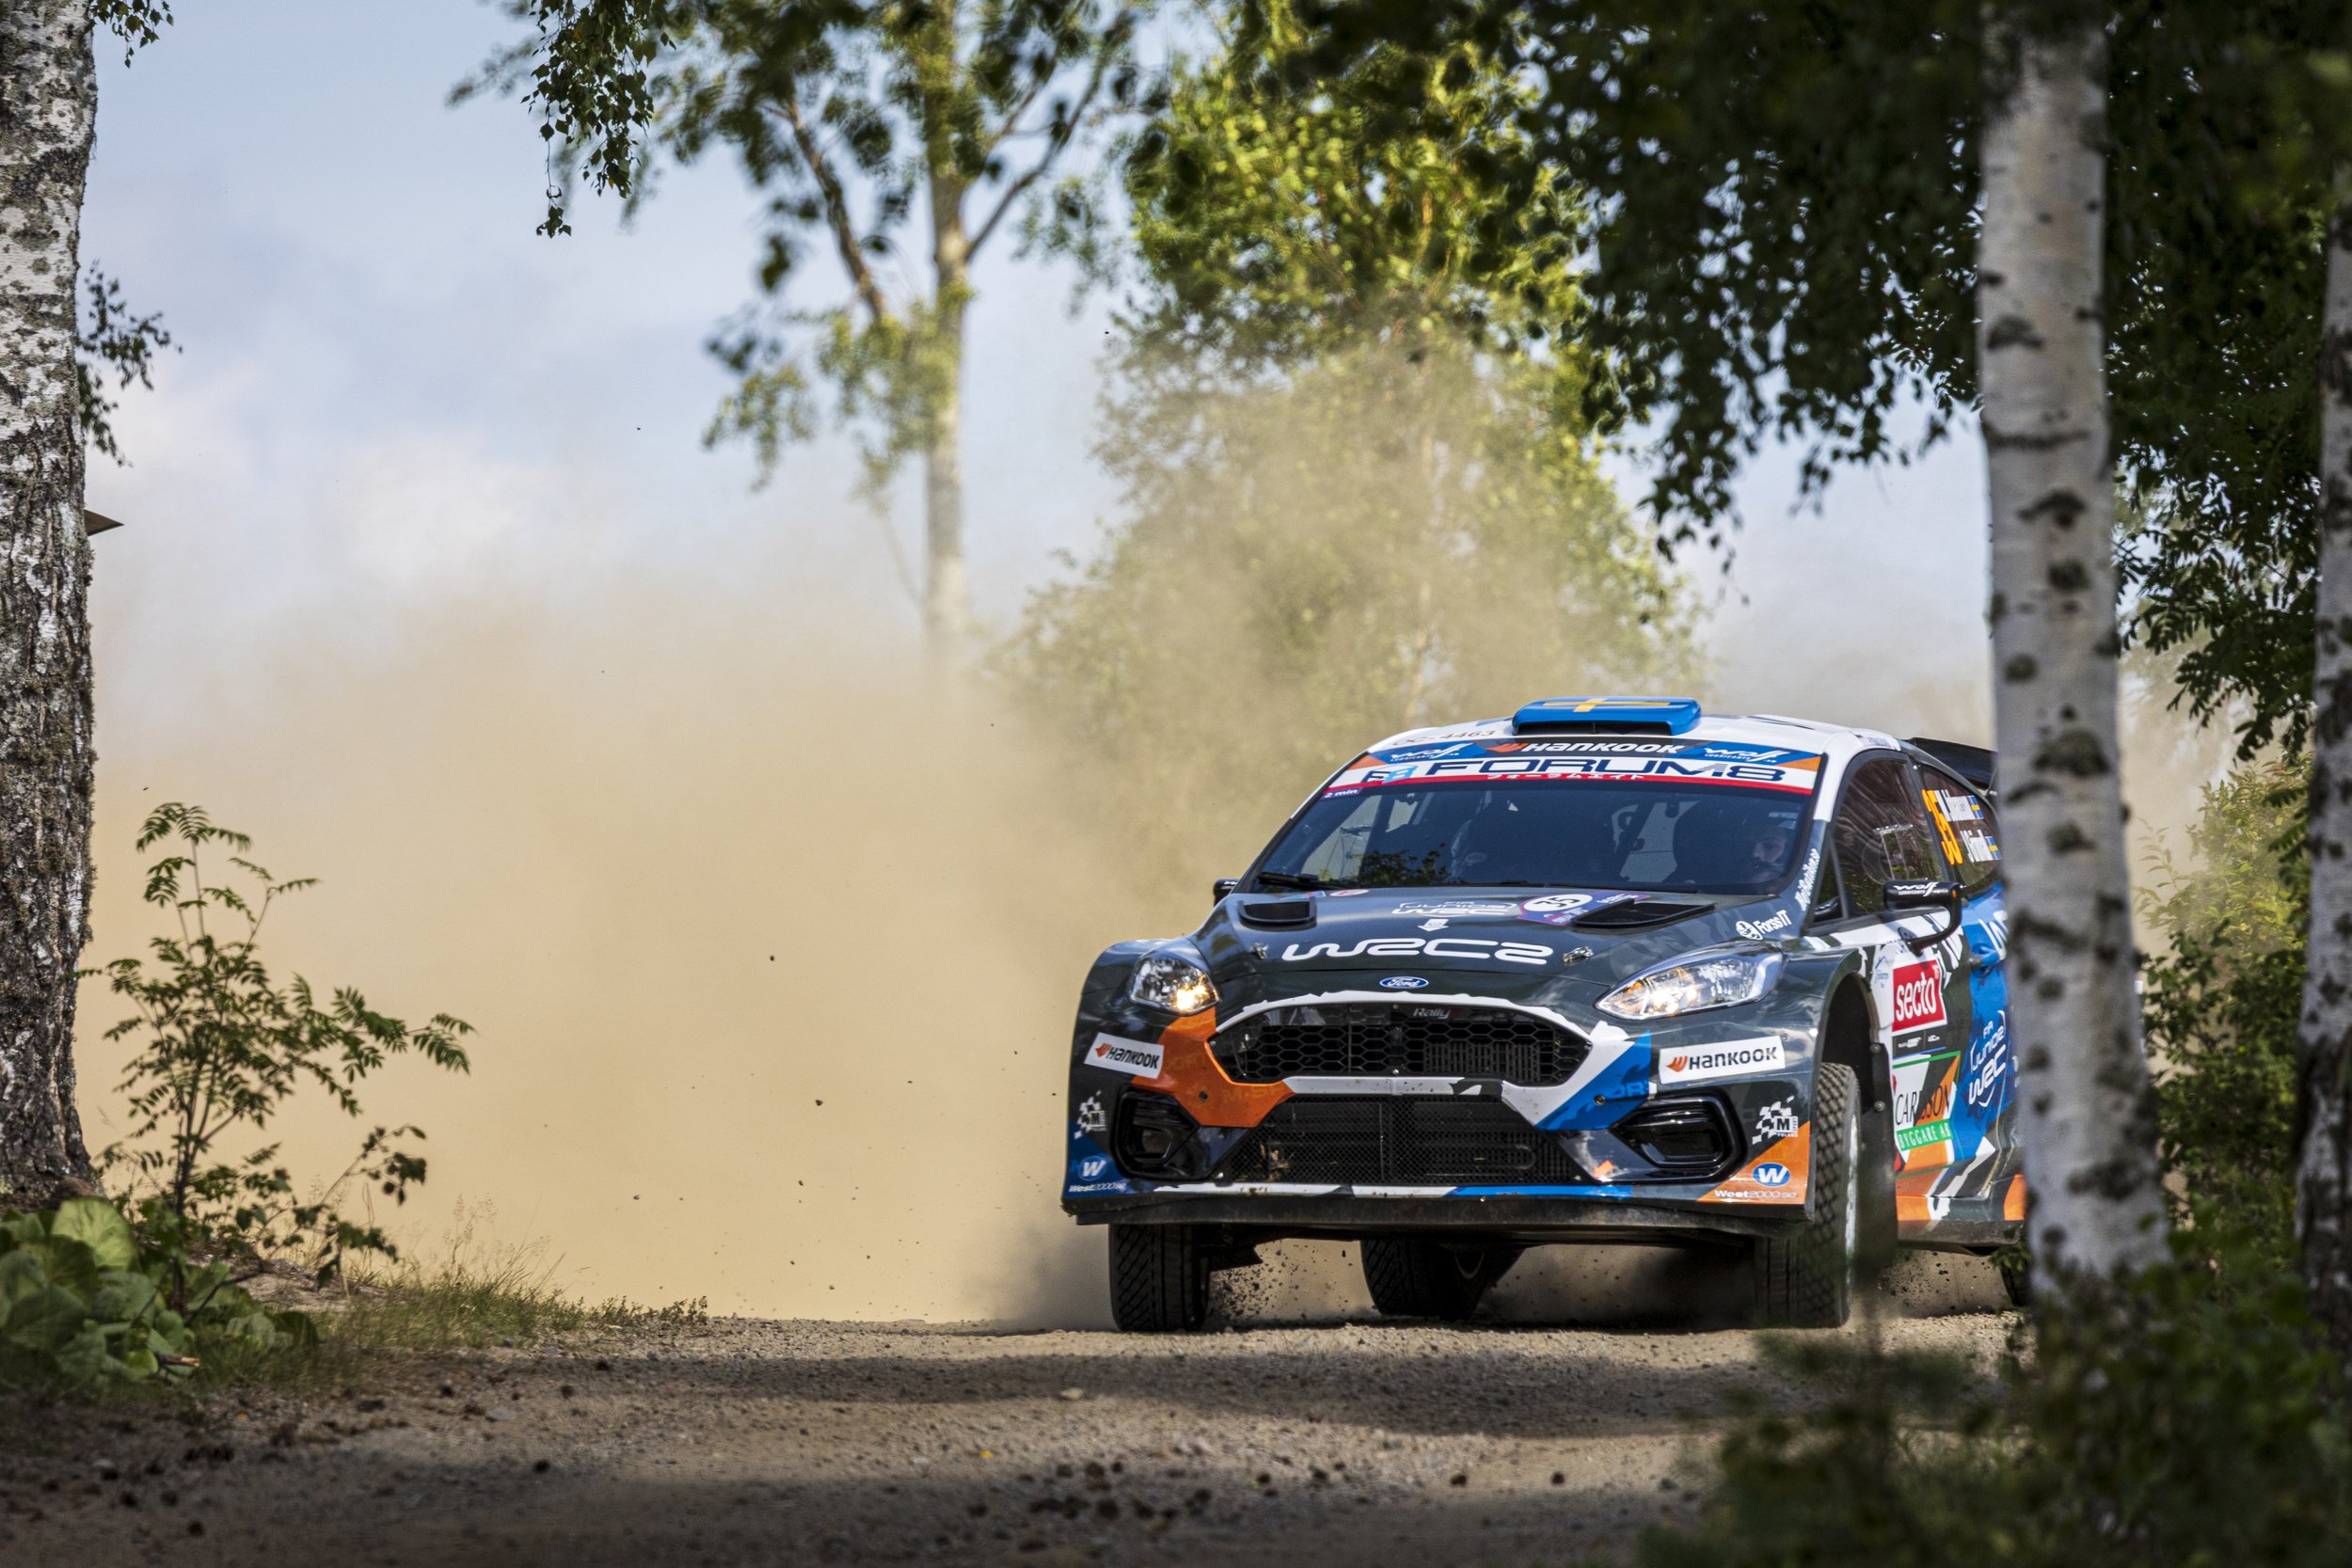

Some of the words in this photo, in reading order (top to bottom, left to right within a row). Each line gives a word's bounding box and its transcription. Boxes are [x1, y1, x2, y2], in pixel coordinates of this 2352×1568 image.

[1521, 742, 1686, 754] HANKOOK
[1425, 759, 1787, 783] FORUM8
[1535, 896, 1581, 909] 35
[1281, 938, 1554, 965] WRC2
[1387, 978, 1422, 987] Ford
[1896, 971, 1936, 1022] secto
[1413, 1007, 1460, 1020] Rally
[1105, 1045, 1160, 1069] HANKOOK
[1689, 1046, 1778, 1070] HANKOOK
[1968, 1044, 2006, 1105] WRC
[1896, 1084, 1951, 1126] CARSON
[1898, 1126, 1938, 1149] BYGGARE
[1940, 1122, 1951, 1138] AB
[1757, 1164, 1788, 1183] W
